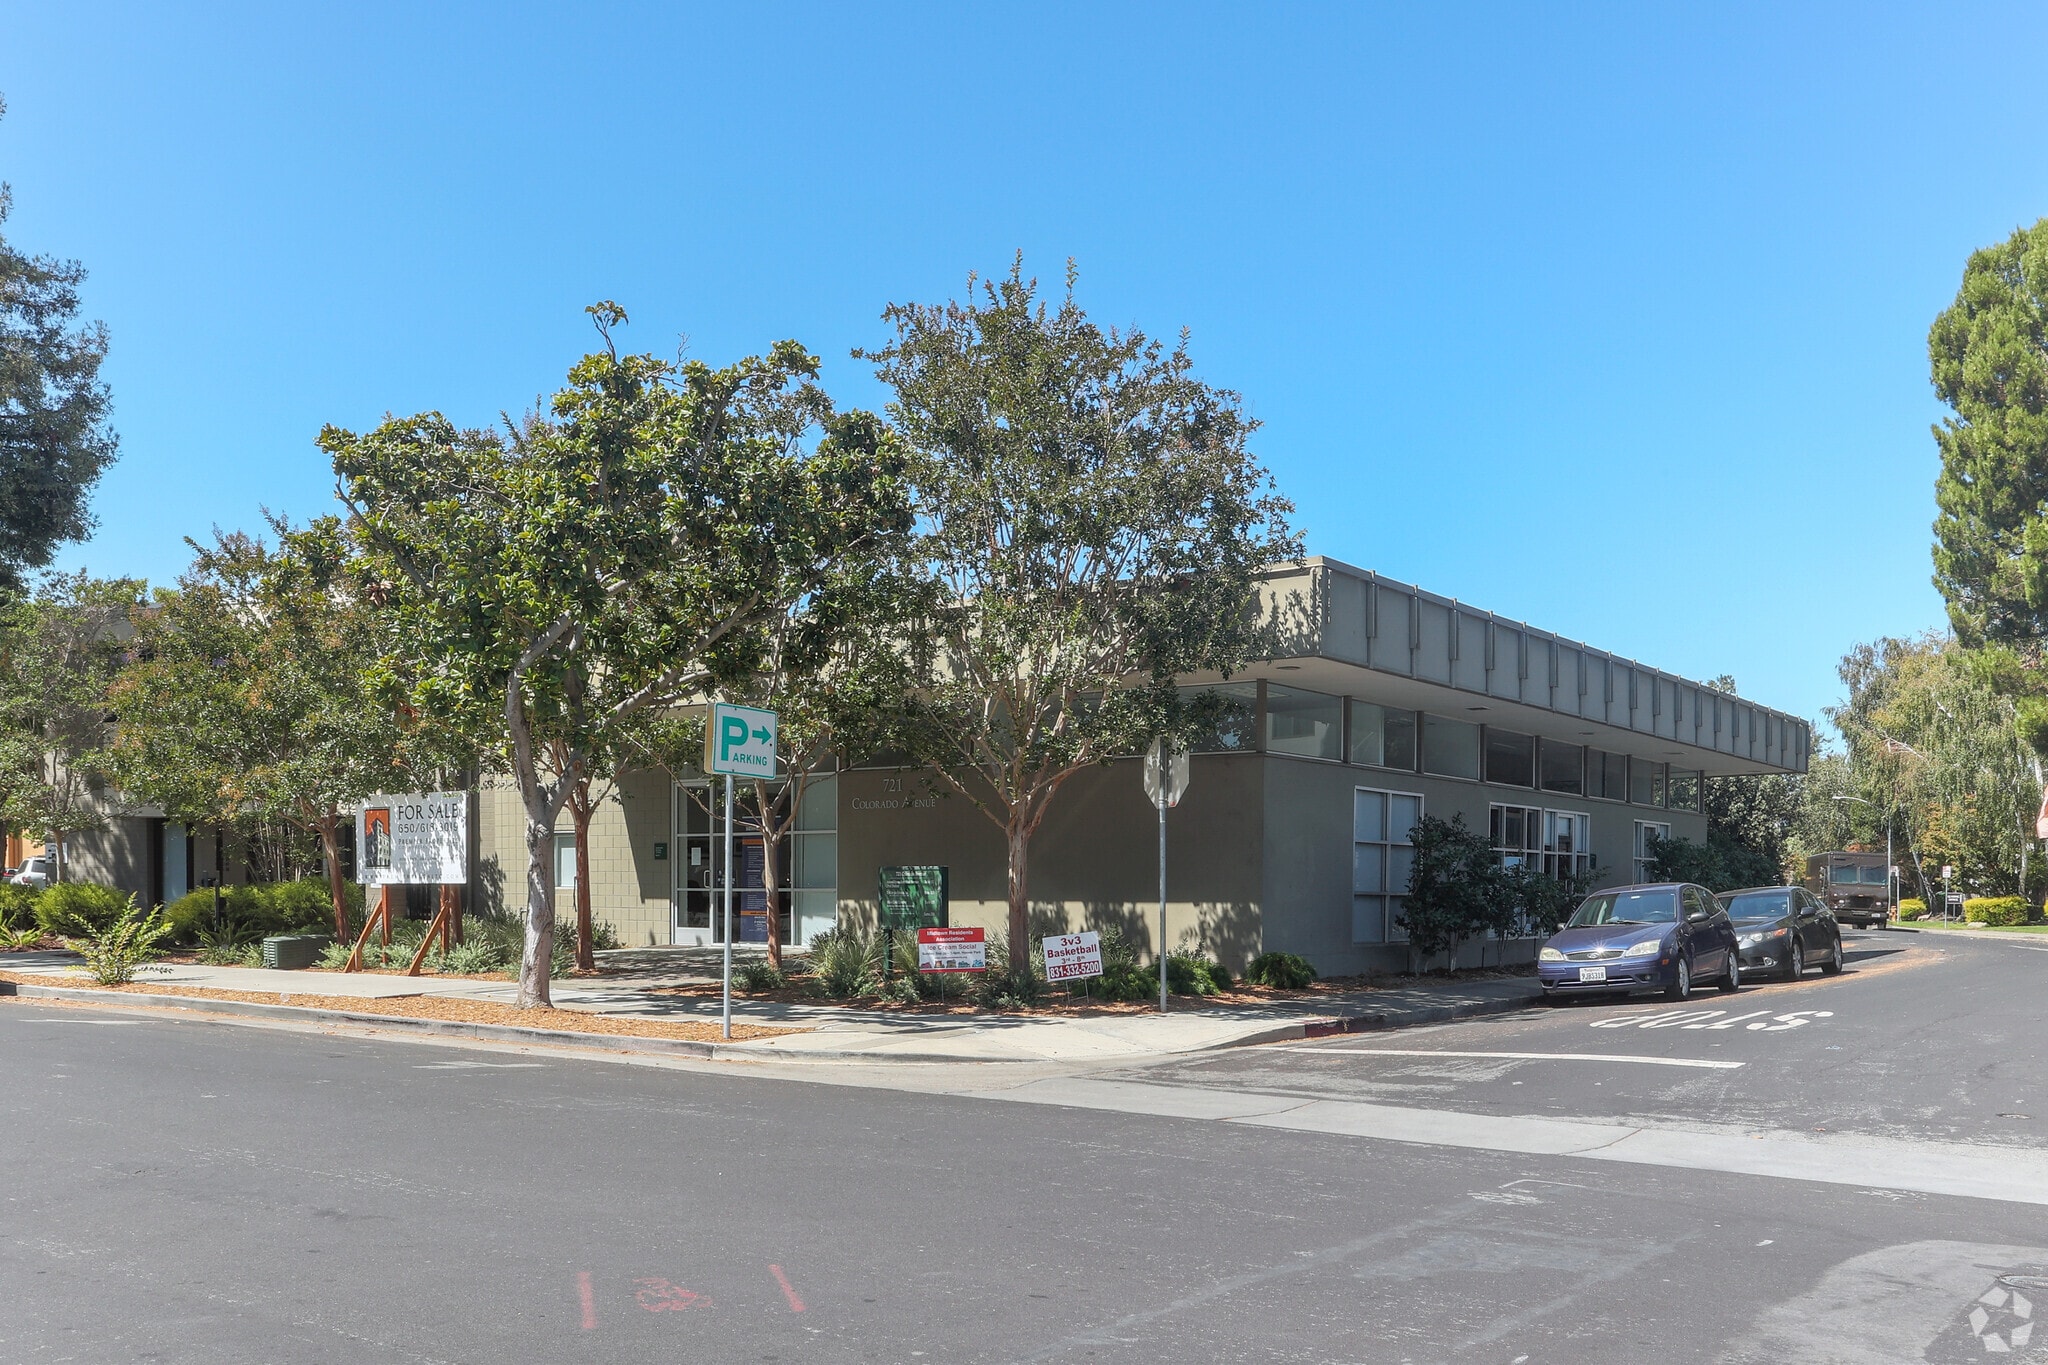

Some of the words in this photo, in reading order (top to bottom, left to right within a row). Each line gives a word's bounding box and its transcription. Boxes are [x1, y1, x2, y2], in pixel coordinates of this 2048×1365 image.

[883, 778, 903, 792] 721
[901, 796, 936, 809] AENUE
[398, 804, 424, 820] FOR
[428, 803, 459, 819] SALE
[1061, 936, 1082, 947] 3v3
[1047, 944, 1097, 958] Basketball
[1050, 961, 1099, 978] 831-332-5200
